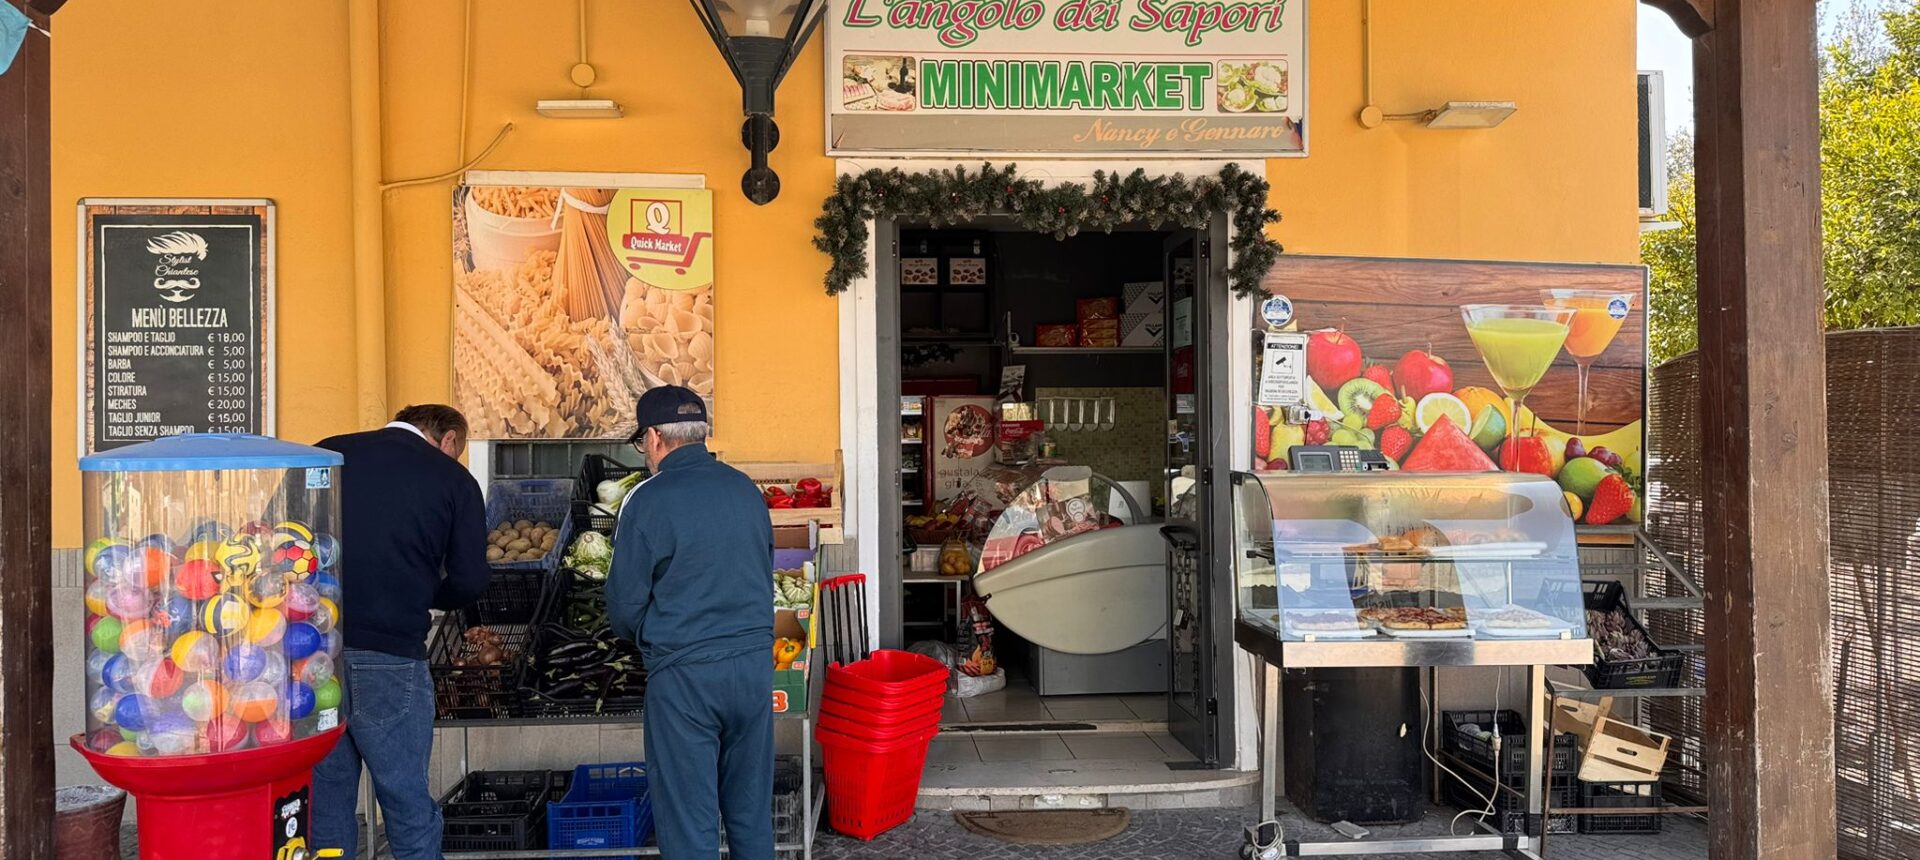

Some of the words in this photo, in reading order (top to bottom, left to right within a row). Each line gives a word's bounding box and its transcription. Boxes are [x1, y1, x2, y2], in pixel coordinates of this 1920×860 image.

[842, 0, 1044, 48] Langolo
[1053, 0, 1119, 32] dei
[1129, 0, 1283, 46] Sapori
[920, 59, 1213, 111] MINIMARKET
[1073, 118, 1161, 148] Nancy
[1166, 128, 1178, 141] e
[1180, 118, 1284, 142] Gennaro
[646, 201, 672, 235] Q
[630, 236, 654, 249] Quick
[655, 239, 682, 252] Market
[131, 304, 166, 328] MENÙ
[168, 307, 228, 328] BELLEZZA
[107, 331, 143, 343] SHAMPOO
[144, 331, 149, 343] E
[151, 331, 176, 343] TAGLIO
[207, 333, 215, 343] €
[217, 332, 245, 344] 18,00
[107, 345, 143, 356] SHAMPOO
[144, 345, 149, 356] E
[150, 345, 204, 356] ACCONCIATURA
[207, 346, 215, 356] €
[223, 346, 245, 358] 5,00
[107, 358, 131, 370] BARBA
[207, 359, 215, 369] €
[223, 359, 245, 371] 5,00
[107, 372, 136, 383] COLORE
[207, 373, 215, 383] €
[217, 372, 245, 384] 15,00
[107, 385, 147, 396] STIRATURA
[207, 386, 215, 396] €
[217, 386, 245, 398] 15,00
[107, 398, 137, 410] MECHES
[207, 399, 215, 409] €
[217, 399, 245, 411] 20,00
[108, 412, 133, 423] TAGLIO
[134, 412, 161, 423] JUNIOR
[207, 413, 215, 423] €
[217, 412, 245, 424] 15,00
[108, 425, 133, 437] TAGLIO
[134, 425, 158, 437] SENZA
[159, 425, 195, 436] SHAMPOO
[217, 426, 245, 434] 1500
